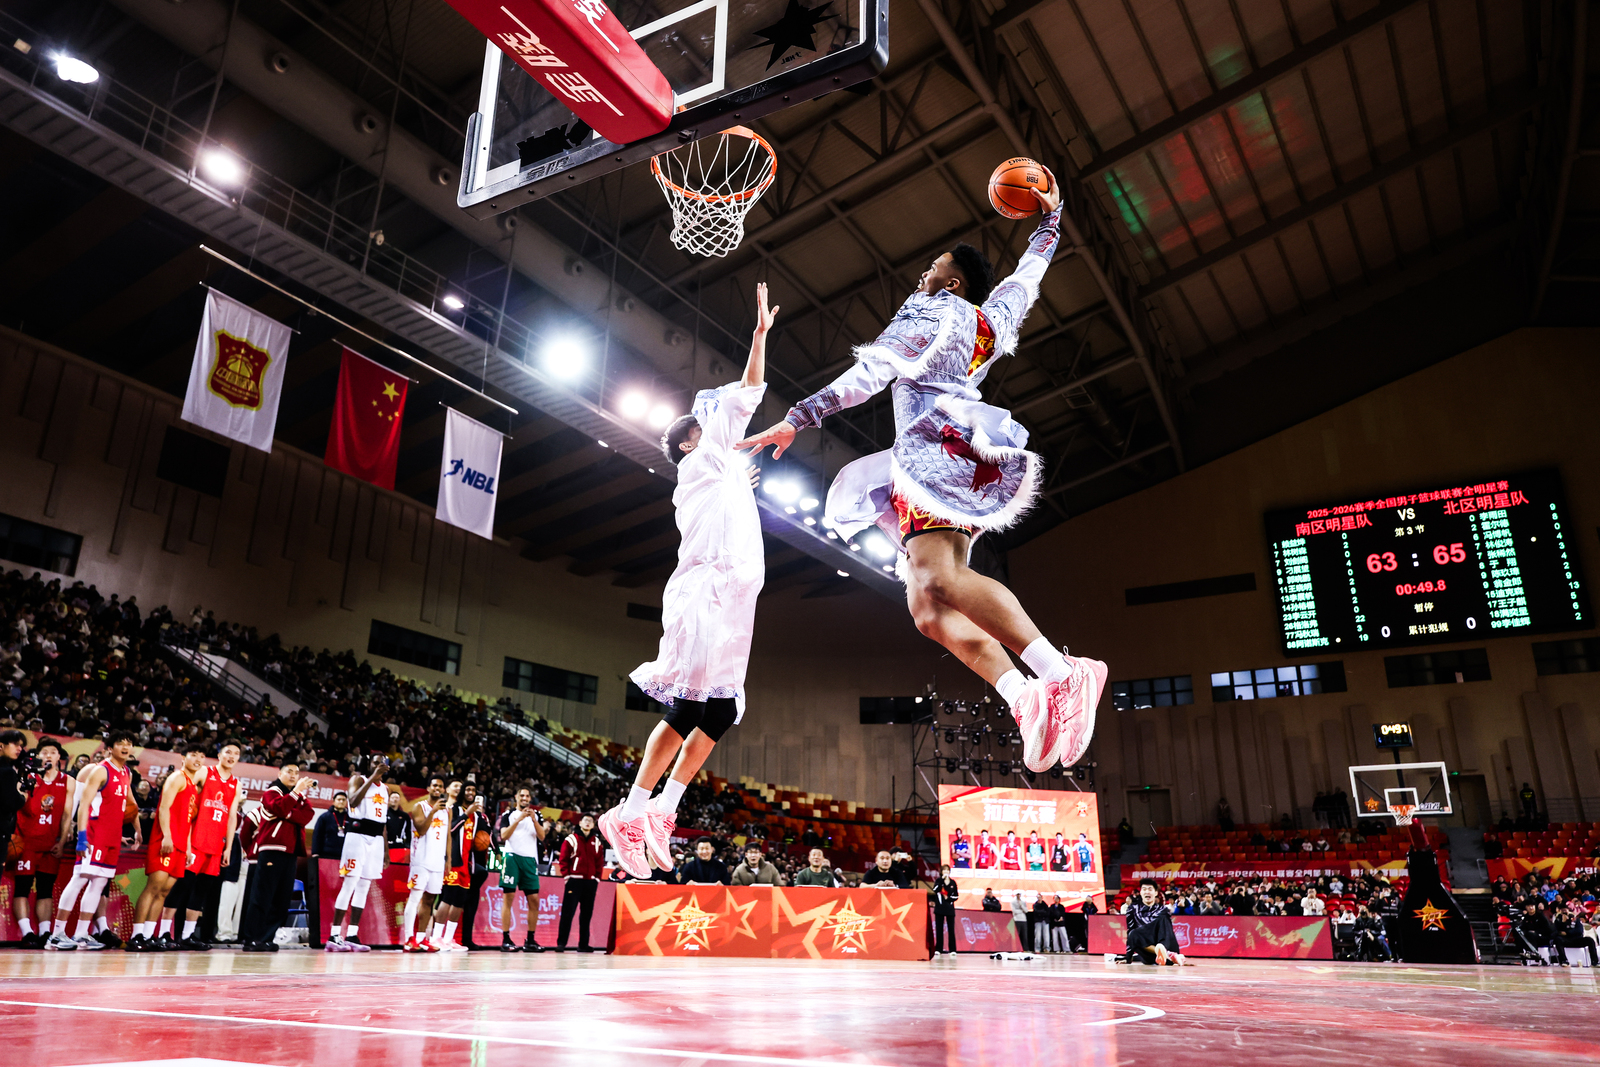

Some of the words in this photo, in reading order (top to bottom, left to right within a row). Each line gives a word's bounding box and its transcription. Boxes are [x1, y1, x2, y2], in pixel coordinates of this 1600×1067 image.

[461, 467, 495, 495] NBL
[1307, 480, 1509, 519] 2025-2026赛季全国男子篮球联赛全明星赛
[1443, 490, 1529, 515] 北区明星队
[1549, 503, 1556, 511] 9
[1397, 507, 1416, 521] VS
[1469, 514, 1476, 522] 0
[1295, 513, 1373, 537] 南区明星队
[1554, 522, 1560, 530] 0
[1406, 526, 1413, 535] 3
[1341, 532, 1347, 540] 0
[1473, 533, 1479, 541] 6
[1556, 531, 1562, 539] 4
[1343, 541, 1349, 549] 2
[1475, 542, 1480, 550] 7
[1344, 550, 1351, 558] 0
[1366, 552, 1398, 573] 63
[1433, 542, 1466, 565] 65
[1477, 552, 1482, 560] 7
[1561, 551, 1567, 559] 4
[1346, 559, 1352, 567] 4
[1479, 562, 1485, 570] 8
[1563, 562, 1569, 570] 2
[1276, 568, 1282, 576] 9
[1347, 568, 1354, 576] 0
[1481, 571, 1487, 579] 9
[1565, 571, 1572, 579] 9
[1277, 577, 1283, 585] 9
[1349, 577, 1355, 585] 2
[1483, 581, 1489, 589] 9
[1568, 581, 1580, 589] 13
[1350, 587, 1357, 595] 9
[1395, 579, 1447, 596] 00:49.8
[1352, 596, 1358, 604] 2
[1570, 592, 1577, 600] 5
[1353, 605, 1360, 613] 0
[1573, 602, 1579, 610] 6
[1355, 614, 1366, 623] 22
[1575, 612, 1582, 620] 2
[1466, 617, 1476, 629] 0
[1357, 624, 1363, 632] 3
[1381, 626, 1391, 638] 0
[1408, 622, 1449, 635] 累计犯规
[1359, 633, 1369, 642] 19
[212, 809, 223, 822] 13
[375, 807, 382, 818] 15
[983, 804, 1057, 825] 扣篮大赛
[39, 814, 52, 825] 24
[435, 831, 441, 840] 2
[95, 849, 102, 860] 0
[18, 860, 31, 870] 24
[347, 858, 357, 869] 15
[504, 875, 514, 885] 24
